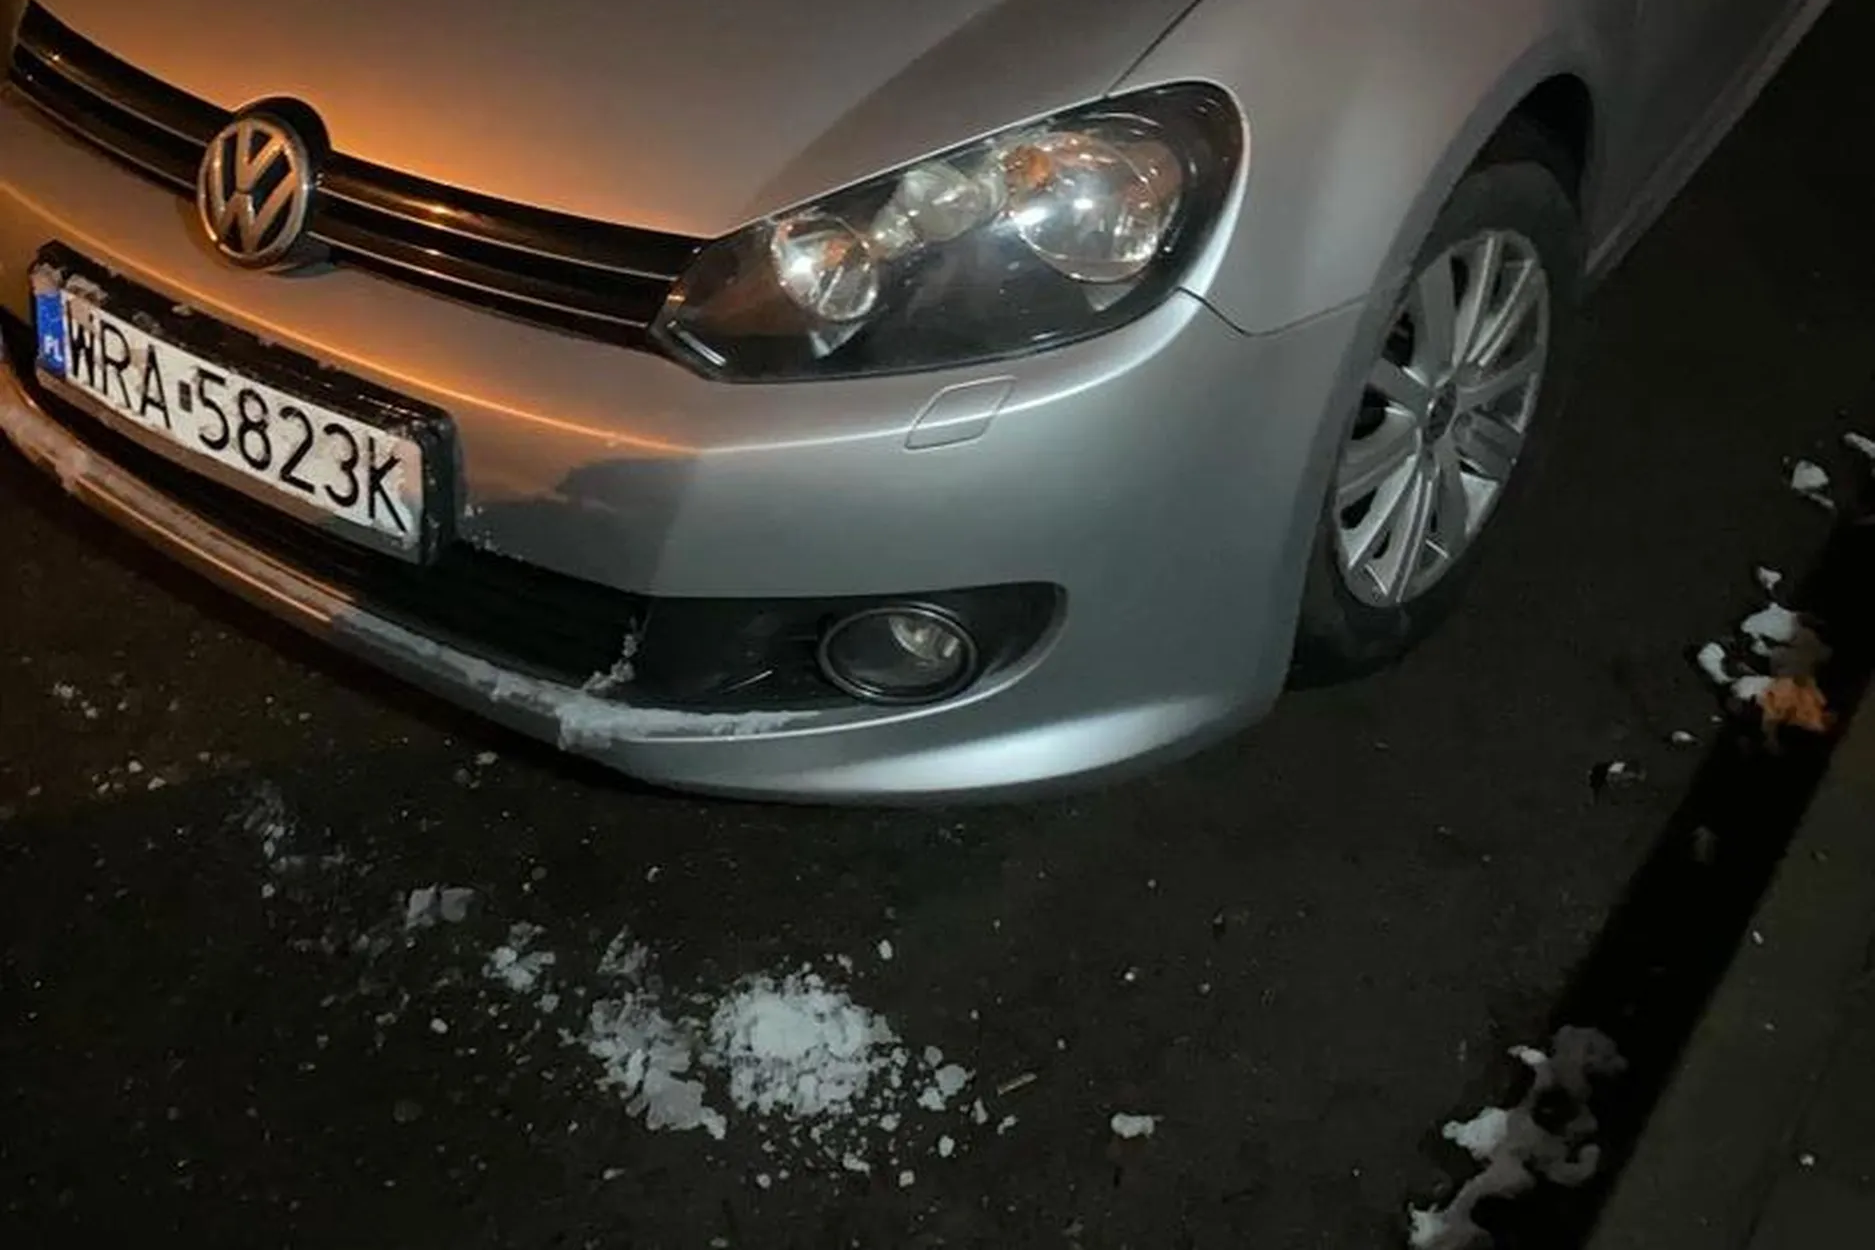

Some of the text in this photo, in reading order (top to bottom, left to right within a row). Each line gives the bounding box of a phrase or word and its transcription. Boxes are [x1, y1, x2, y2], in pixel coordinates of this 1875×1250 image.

[203, 116, 307, 256] VW
[66, 298, 406, 532] WRA 5823K
